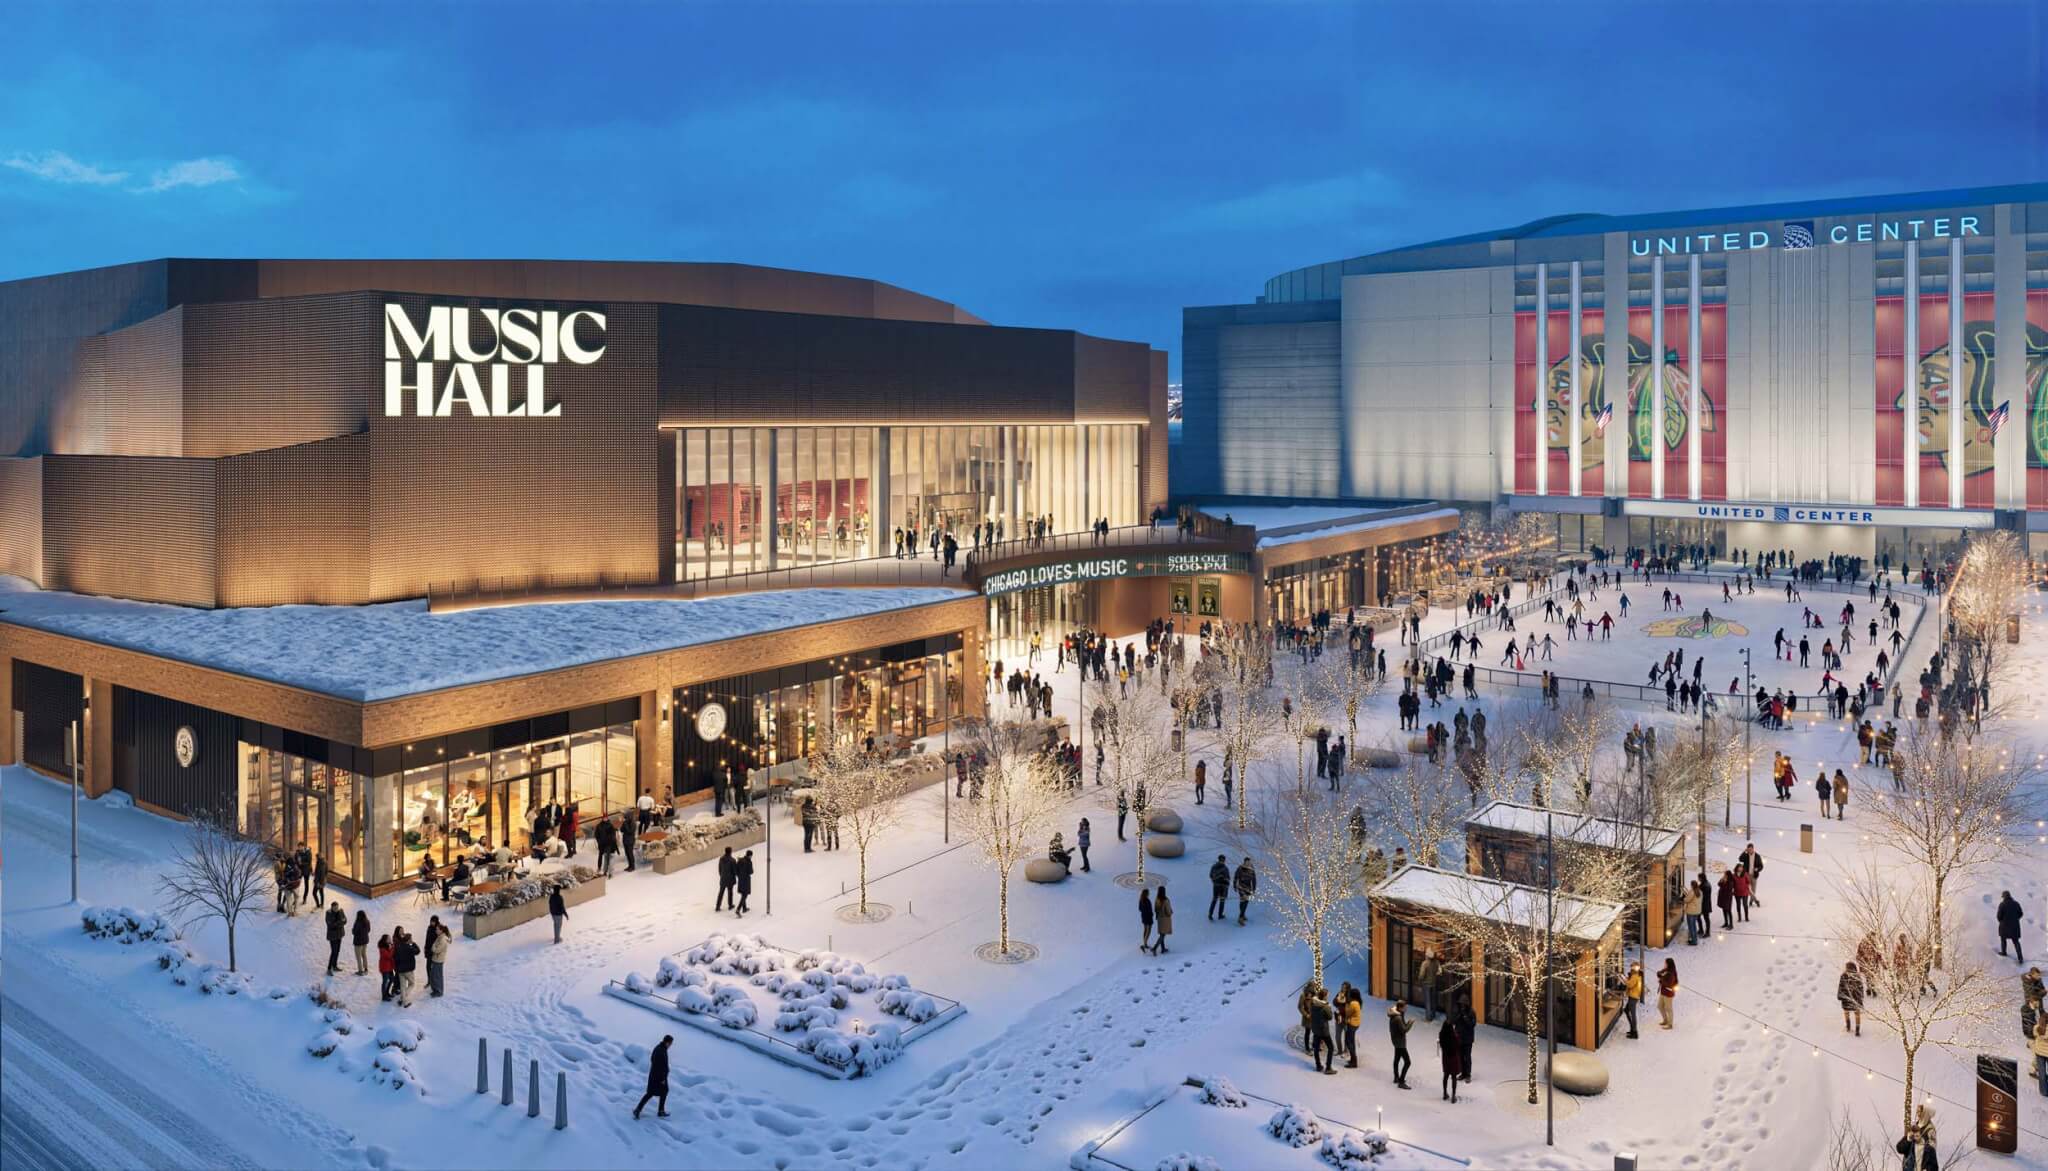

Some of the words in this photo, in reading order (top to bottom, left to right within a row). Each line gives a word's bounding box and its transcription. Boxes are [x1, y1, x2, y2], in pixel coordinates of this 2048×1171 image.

[1632, 232, 1769, 256] UNITED
[1831, 216, 1980, 243] CENTER
[385, 303, 606, 364] MUSIC
[385, 361, 561, 416] HALL
[1698, 507, 1764, 518] UNITED
[1796, 510, 1872, 521] CENTER
[986, 570, 1027, 595] CHICAGO
[1031, 564, 1072, 584] LOVES
[1077, 559, 1127, 578] MUSIC
[1168, 555, 1199, 564] SOLD
[1201, 555, 1229, 563] OUT
[1168, 562, 1199, 573] 7:00
[1203, 561, 1229, 571] PM
